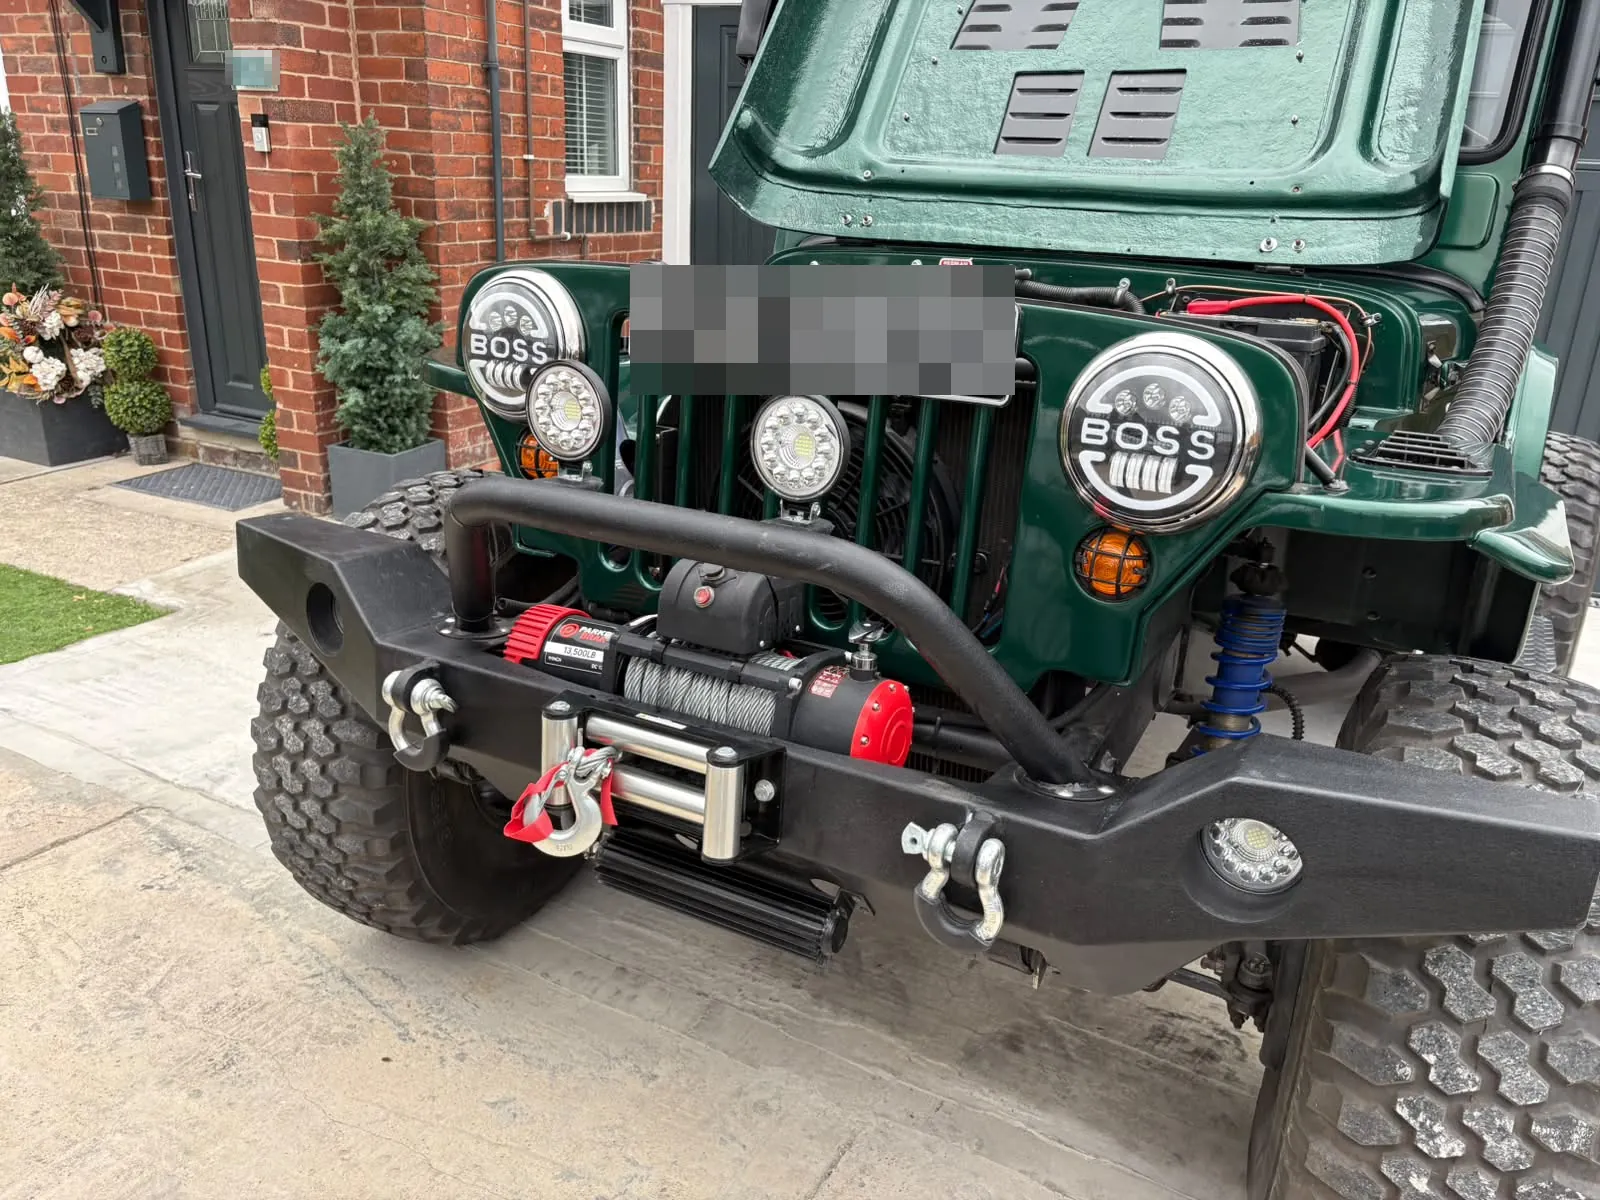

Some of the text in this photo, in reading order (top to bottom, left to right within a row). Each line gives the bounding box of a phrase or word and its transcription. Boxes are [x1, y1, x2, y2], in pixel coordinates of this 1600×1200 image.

[470, 333, 549, 365] BOSS
[1080, 417, 1216, 461] BOSS
[563, 646, 597, 659] 13,500LB
